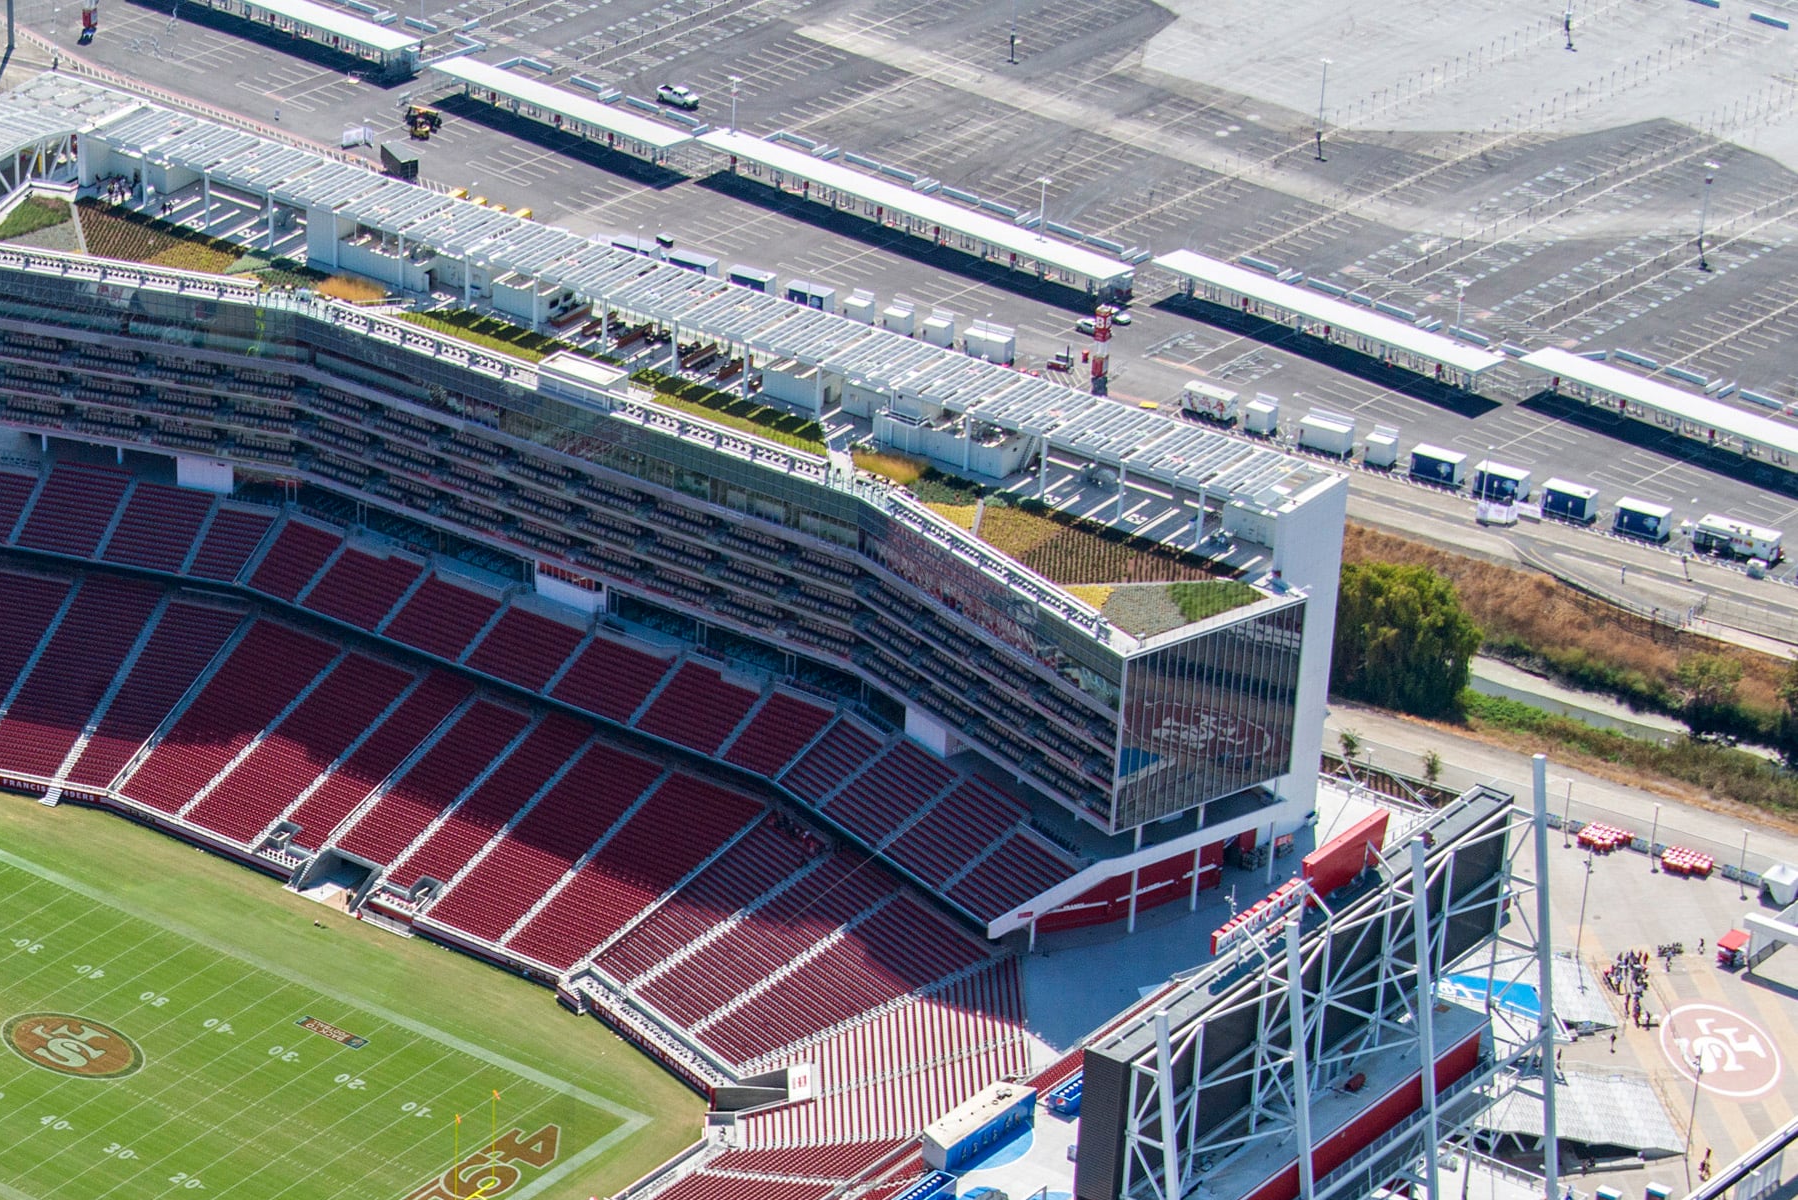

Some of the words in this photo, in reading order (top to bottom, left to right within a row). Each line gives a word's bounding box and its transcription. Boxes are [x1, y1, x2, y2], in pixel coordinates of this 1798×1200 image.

[3, 778, 48, 793] FRANCIS
[64, 790, 95, 802] 49ERS
[14, 938, 44, 954] 30
[77, 963, 105, 979] 40
[139, 991, 170, 1008] 50
[203, 1018, 232, 1034] 40
[305, 1023, 318, 1031] TO
[314, 1019, 351, 1038] FOOTBALL
[322, 1028, 345, 1041] BACK
[268, 1045, 299, 1062] 30
[619, 1021, 642, 1041] SUPER
[643, 1038, 663, 1058] BOWL
[664, 1056, 707, 1091] CHAMPIONS
[333, 1073, 365, 1090] 20
[401, 1101, 429, 1118] 10
[40, 1114, 69, 1131] 40
[103, 1142, 135, 1160] 30
[169, 1172, 201, 1190] 20
